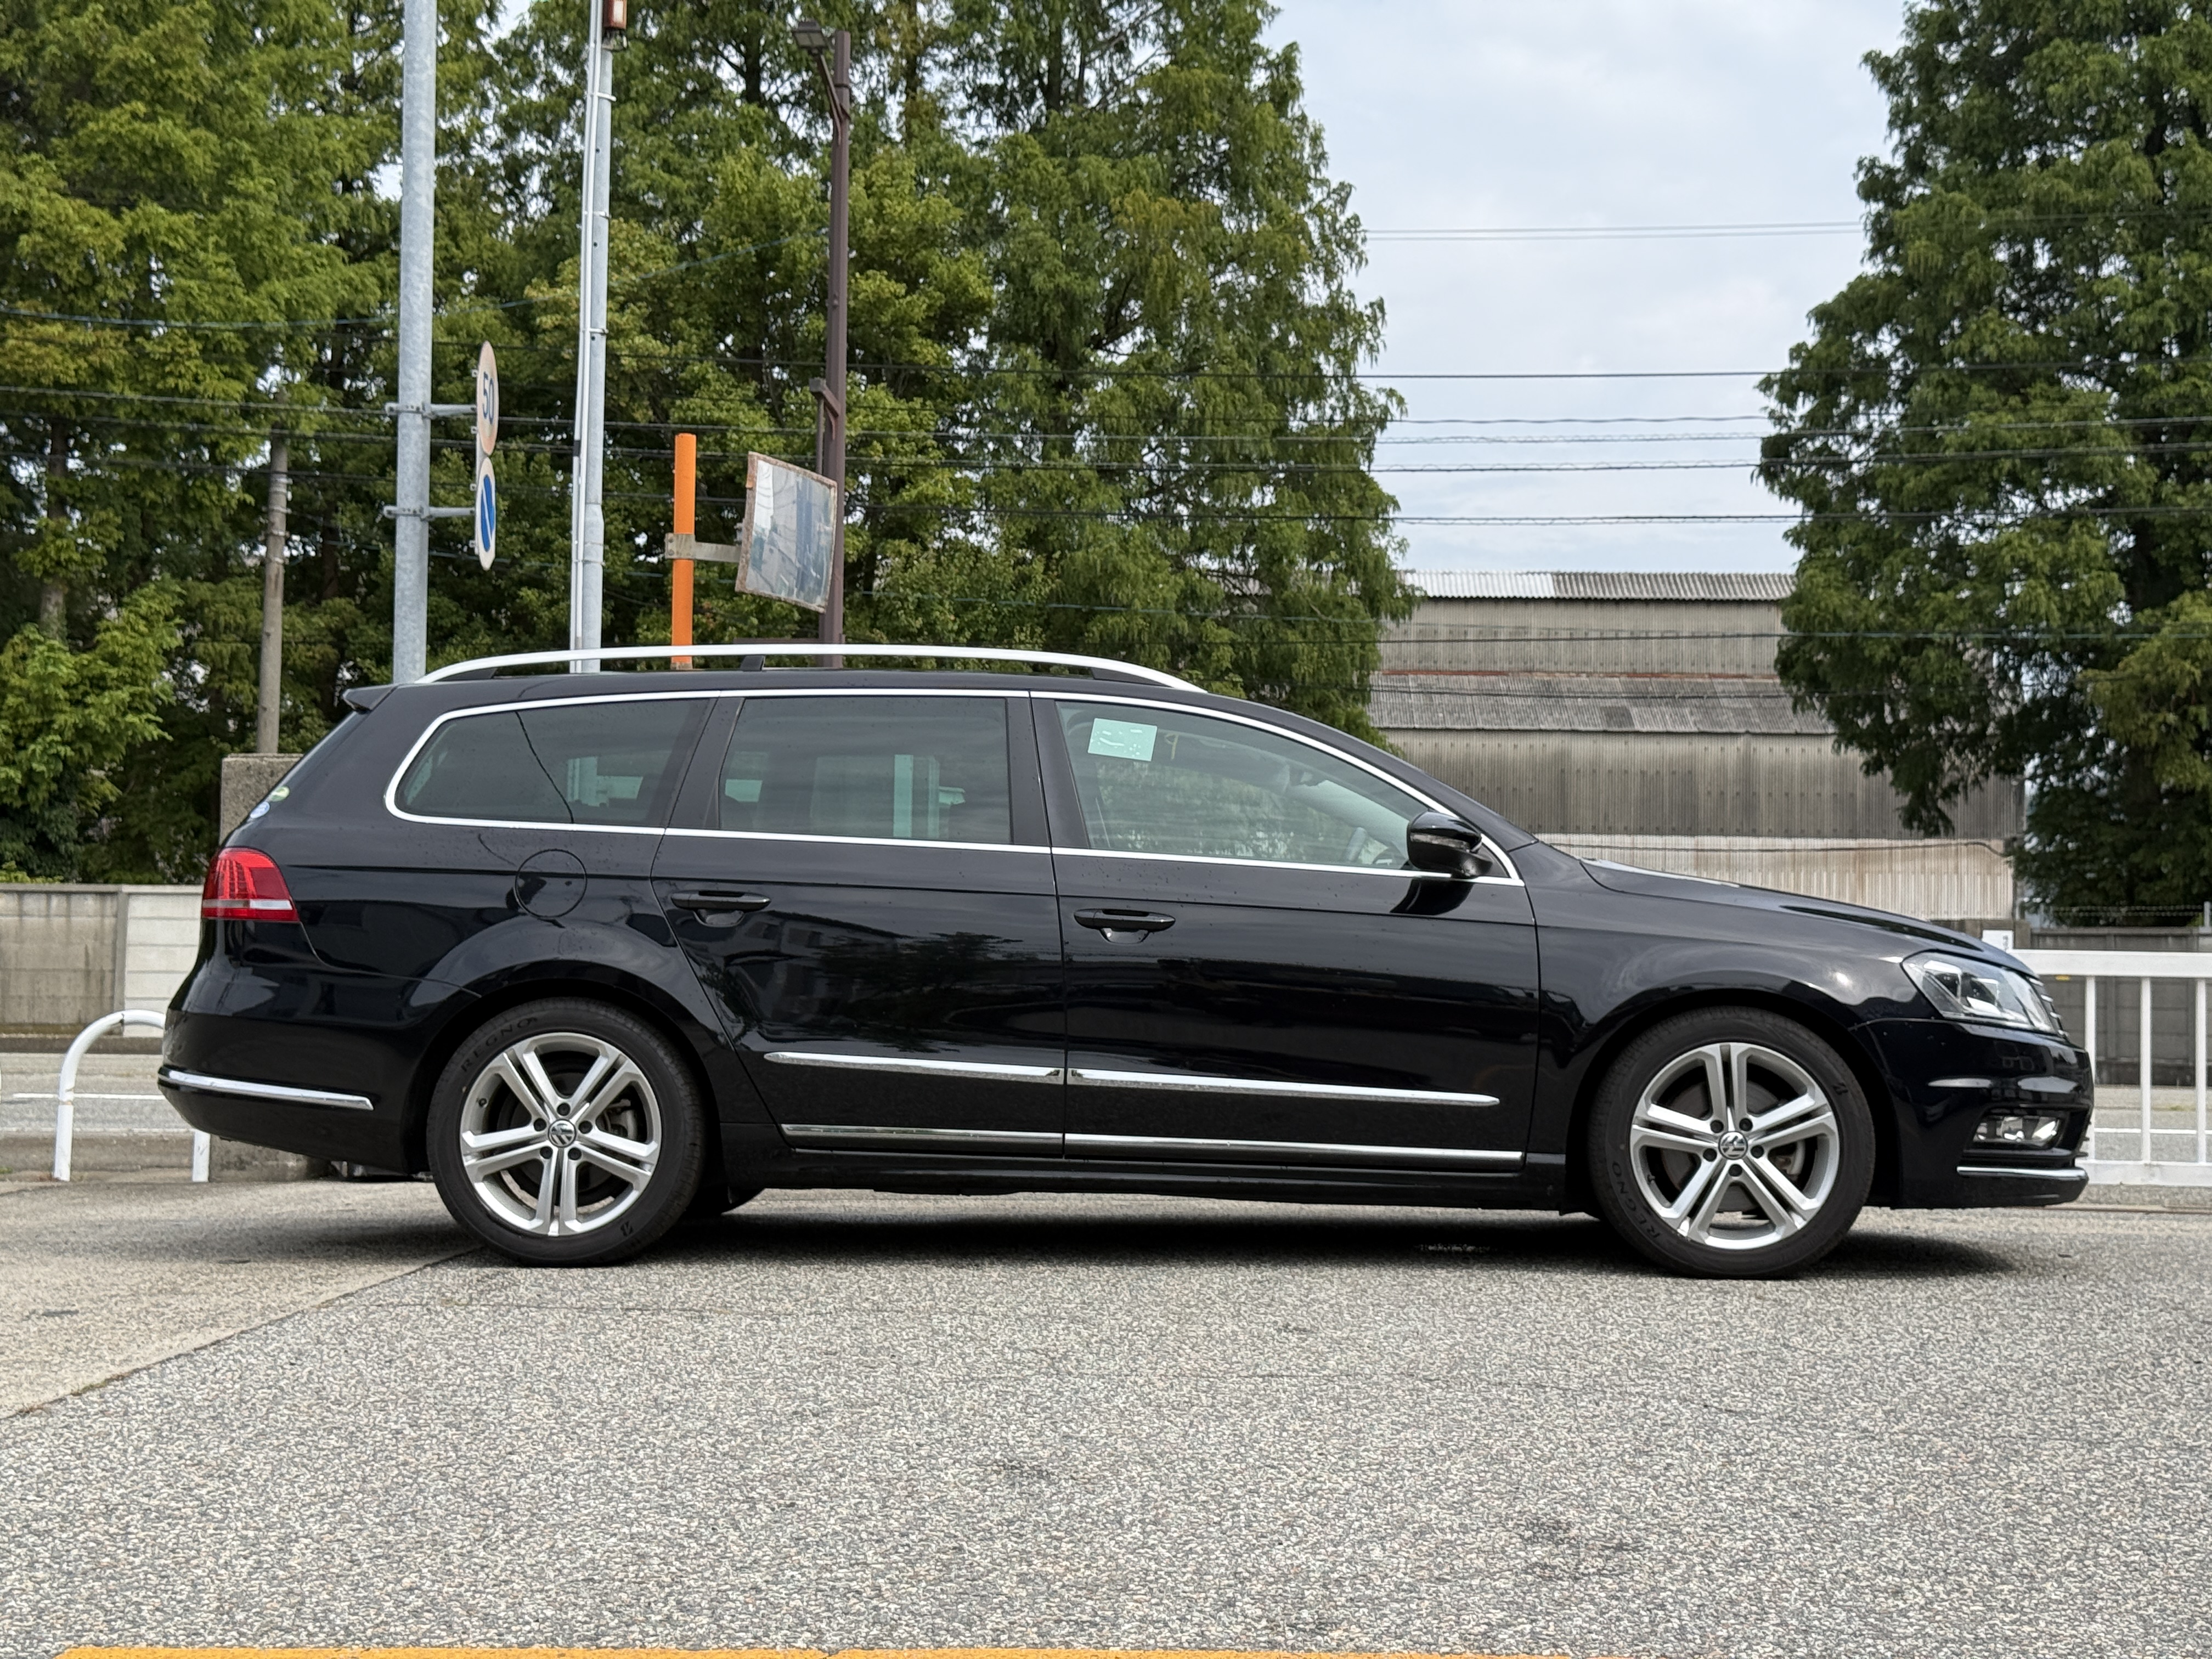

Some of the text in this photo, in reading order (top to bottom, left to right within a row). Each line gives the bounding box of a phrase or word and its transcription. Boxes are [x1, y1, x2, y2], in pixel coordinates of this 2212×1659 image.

[482, 370, 494, 425] 50
[461, 1017, 537, 1071] REGNO
[1612, 1161, 1660, 1238] REGNO
